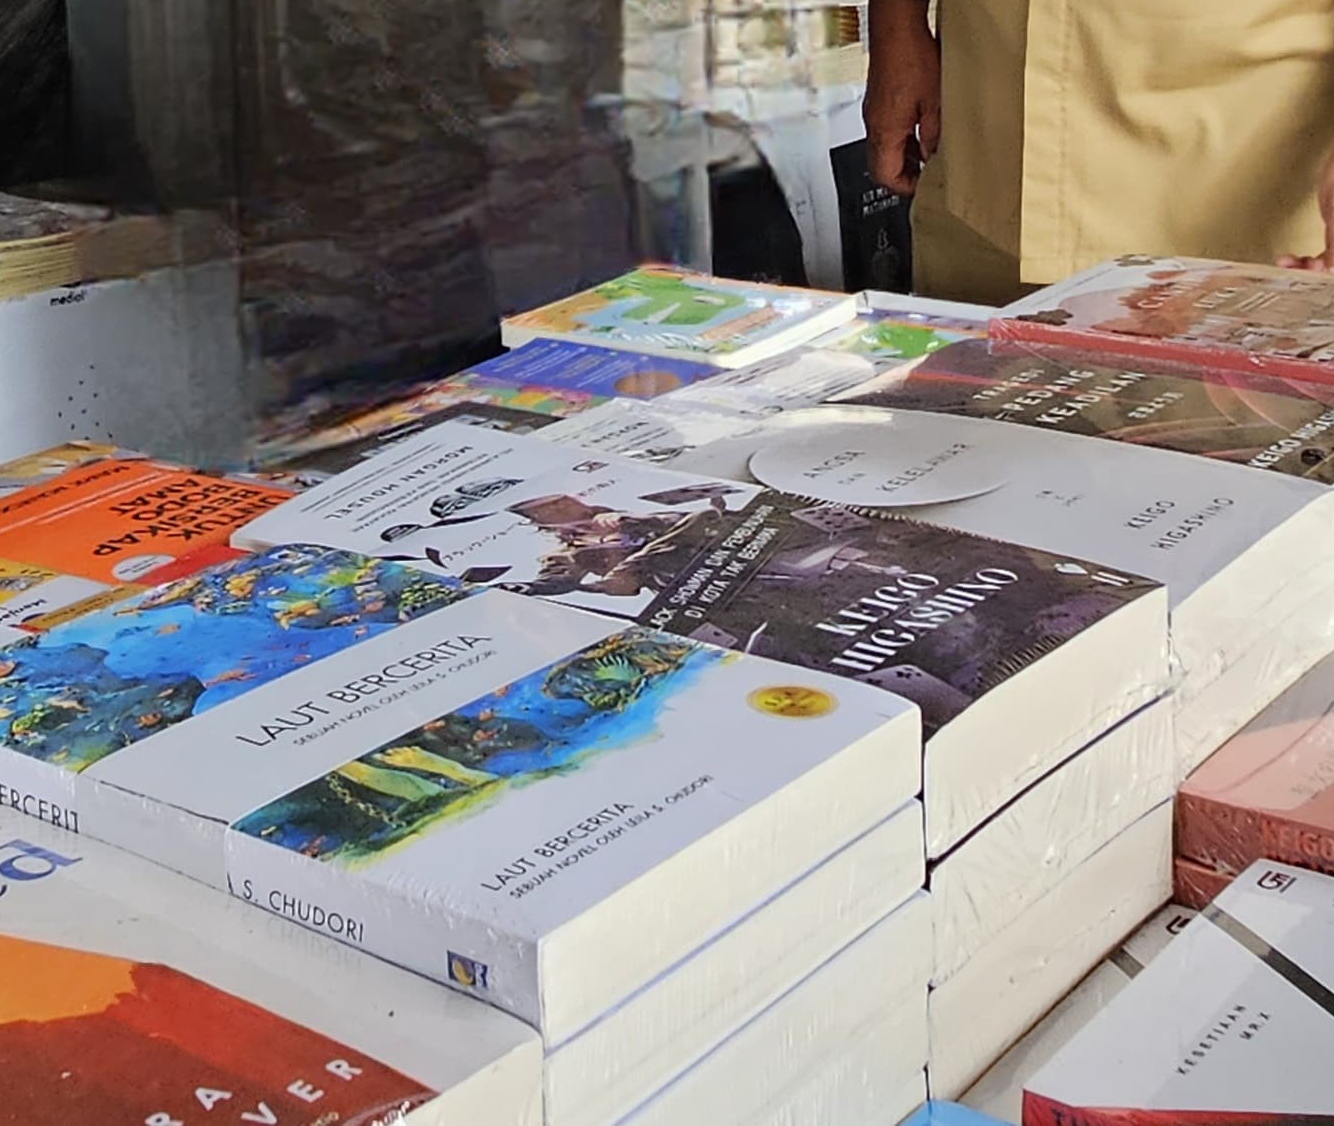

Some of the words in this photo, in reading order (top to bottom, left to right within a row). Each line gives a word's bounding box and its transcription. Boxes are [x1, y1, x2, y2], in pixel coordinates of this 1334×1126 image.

[1012, 369, 1095, 414] PEDANG
[1033, 370, 1148, 426] KEADILAN
[402, 444, 473, 477] MORGAN
[803, 449, 867, 479] ANGSA
[1248, 432, 1302, 467] KEIGO
[93, 484, 260, 556] BERSIKAP
[111, 478, 201, 515] AMAT
[131, 484, 233, 521] BODO
[324, 480, 399, 520] HOUSEL
[1124, 499, 1176, 531] KEIGO
[1150, 496, 1235, 551] HIGASHINO
[688, 603, 705, 620] DI
[700, 580, 731, 610] KOTA
[722, 562, 744, 582] TAK
[816, 571, 941, 639] KEIGO
[829, 567, 1020, 672] HIGASHINO
[235, 699, 318, 749] LAUT
[326, 632, 495, 706] BERCERITA
[293, 719, 342, 747] SEBUAH
[340, 702, 380, 728] NOVEL
[379, 689, 406, 711] OLEH
[405, 679, 435, 703] LEILA
[480, 858, 535, 892] LAUT
[539, 801, 636, 857] BERCERITA
[509, 868, 557, 900] SEBUAH
[556, 849, 596, 876] NOVEL
[594, 835, 626, 856] OLEH
[624, 818, 653, 843] LEILA
[665, 773, 714, 805] CHUDORI
[267, 888, 365, 945] CHUDORI
[1177, 1004, 1247, 1075] KESETIAAN
